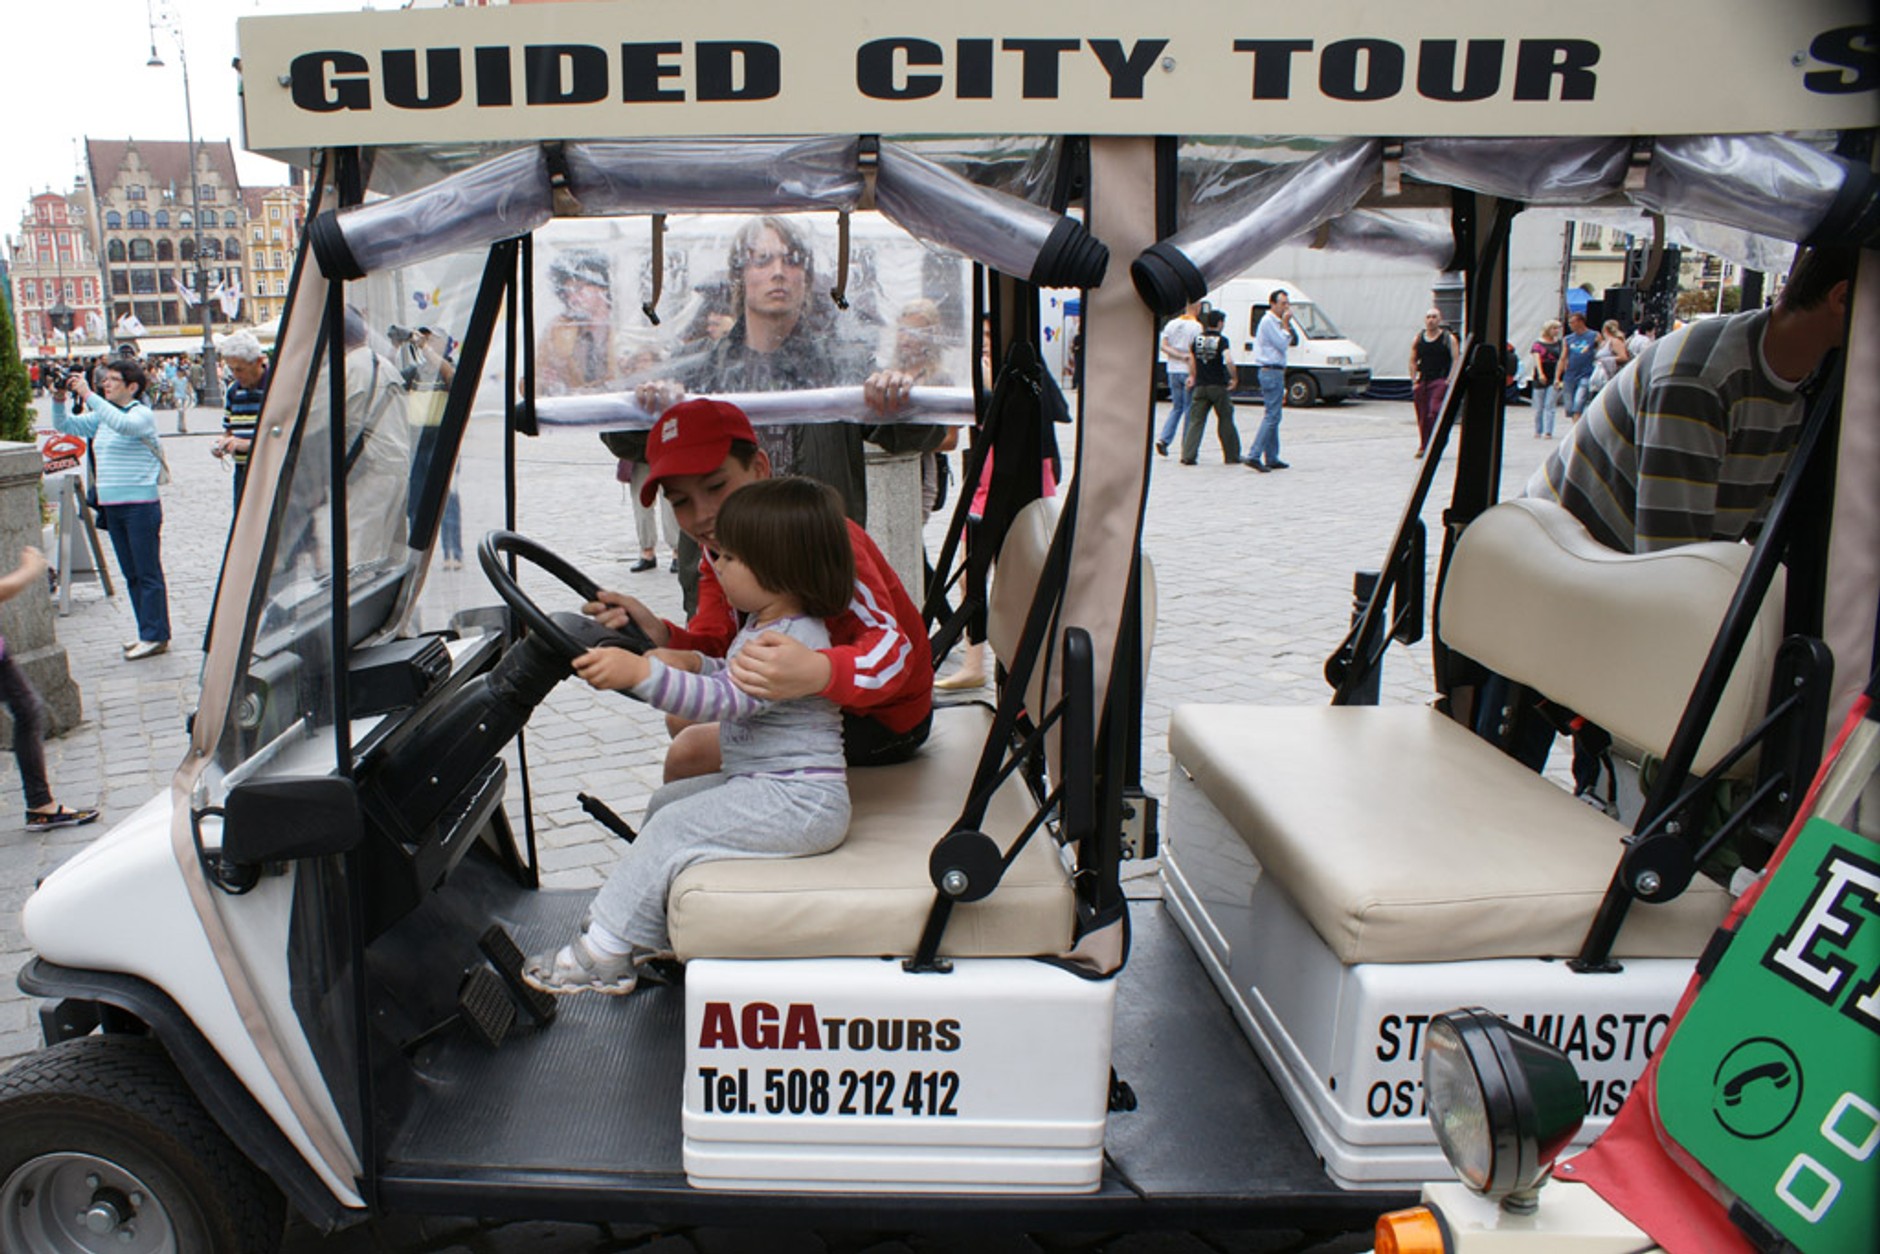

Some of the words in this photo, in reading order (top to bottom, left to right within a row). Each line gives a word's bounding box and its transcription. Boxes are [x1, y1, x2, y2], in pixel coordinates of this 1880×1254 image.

[290, 40, 781, 112] GUIDED
[856, 37, 1170, 101] CITY
[1233, 38, 1601, 102] TOUR
[698, 1067, 757, 1115] Tel.
[764, 1068, 830, 1116] 508
[838, 1069, 896, 1116] 212
[902, 1070, 960, 1117] 412
